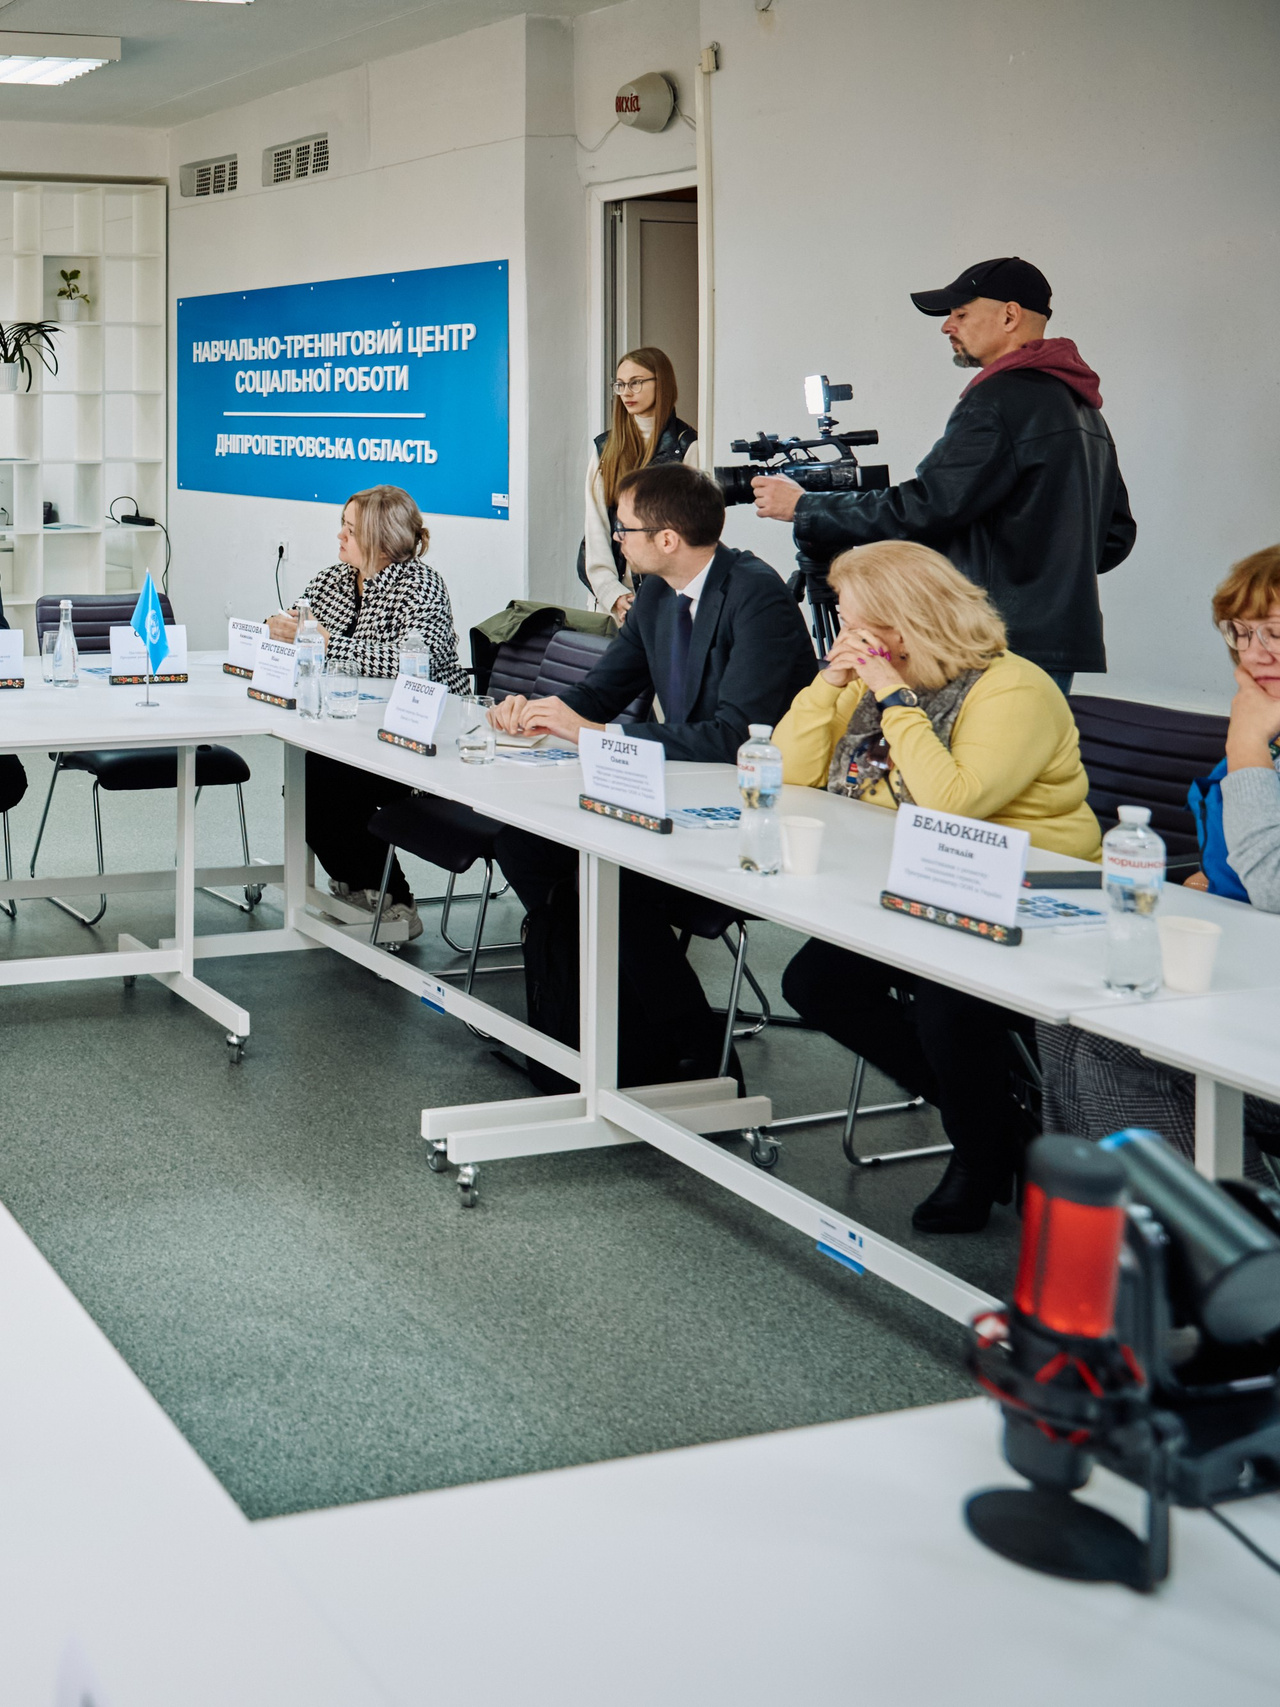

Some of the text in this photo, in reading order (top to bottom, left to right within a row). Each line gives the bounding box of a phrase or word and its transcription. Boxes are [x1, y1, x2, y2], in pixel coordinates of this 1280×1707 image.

[192, 321, 477, 363] НАВЧАЛЬНО-ТРЕНІНГОВИЙ ЦЕНТР
[235, 363, 409, 397] СОЦІАЛЬНОЇ РОБОТИ
[215, 434, 438, 464] ДНІПРОПЕТРОВСЬКА ОБЛАСТЬ
[261, 642, 296, 657] КРІСТЕНСЕН
[404, 680, 435, 695] РУНЕСОН
[601, 738, 638, 755] РУДИЧ
[912, 814, 1008, 849] БЕЛЮКИНА
[937, 843, 974, 859] Наталія
